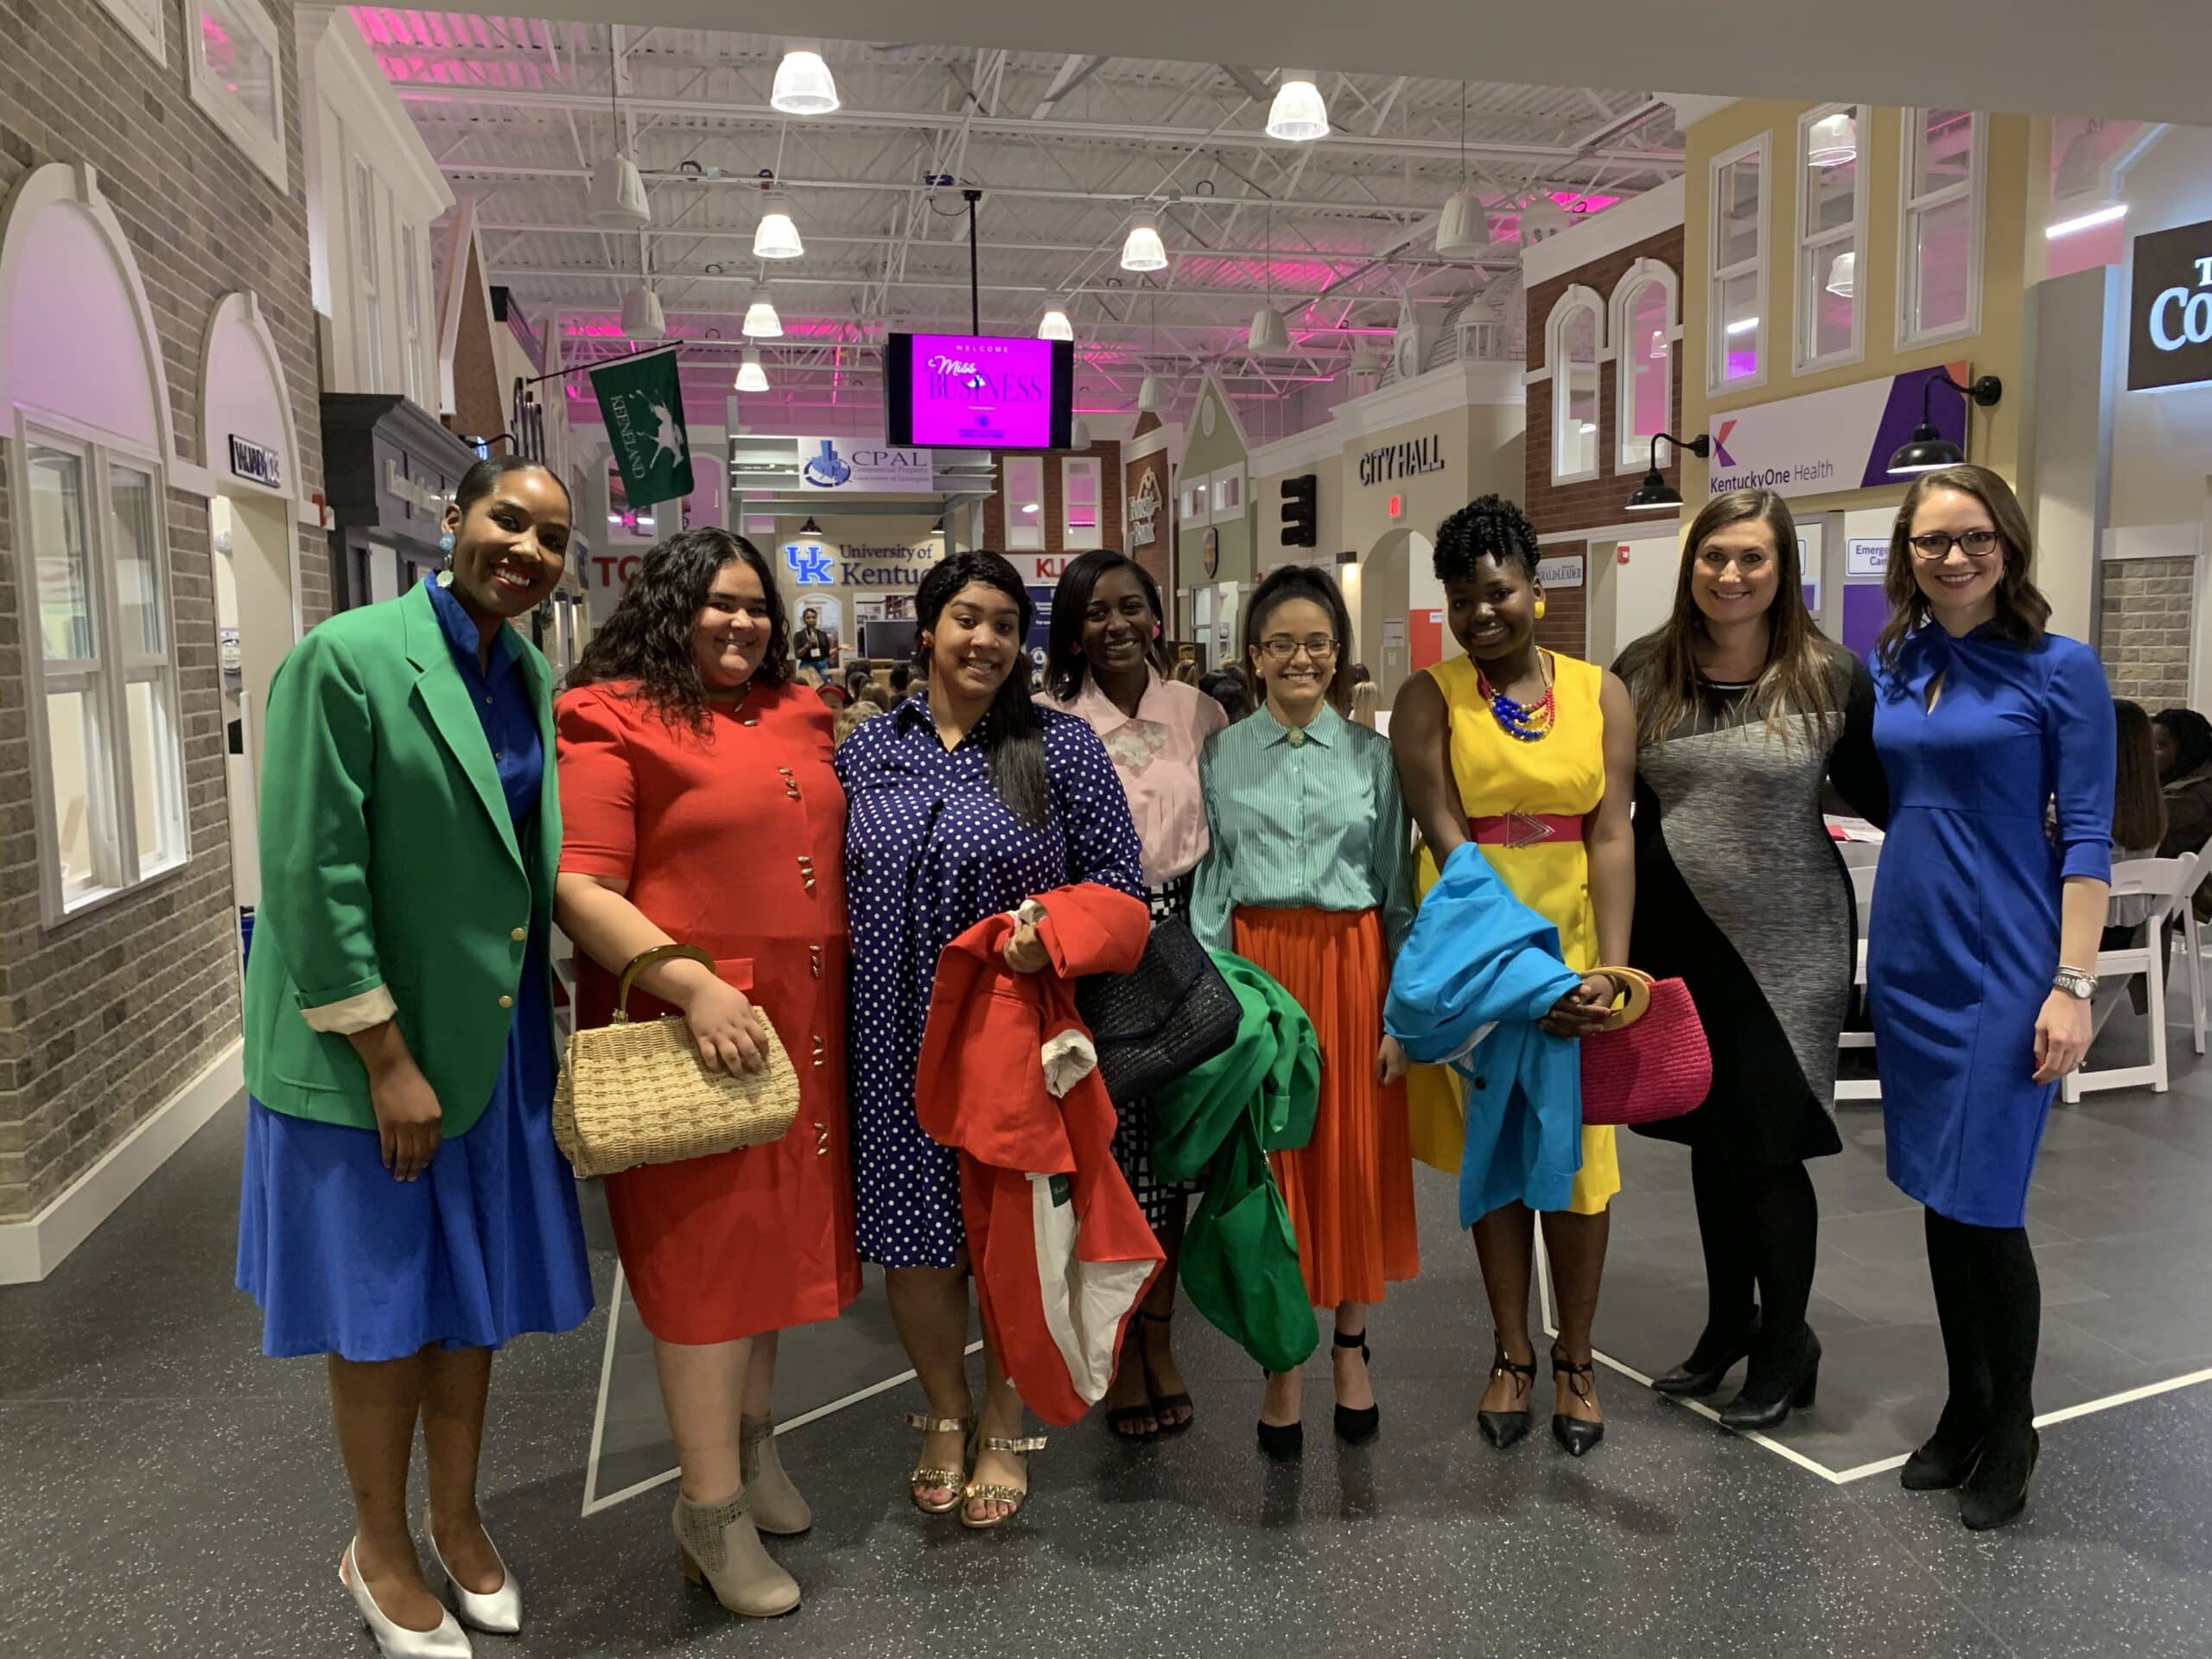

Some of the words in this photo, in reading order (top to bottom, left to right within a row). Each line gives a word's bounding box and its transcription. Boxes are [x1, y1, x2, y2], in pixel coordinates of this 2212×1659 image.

[956, 345, 1009, 353] WELCOME
[928, 355, 977, 376] Miss
[929, 372, 1044, 402] BUSINESS
[610, 395, 645, 480] KEENELAND
[851, 450, 927, 467] CPAL
[1360, 447, 1396, 486] CITY
[1398, 434, 1445, 478] HALL
[1710, 468, 1790, 493] KentuckyOne
[1794, 458, 1834, 481] Health
[785, 545, 834, 585] UK
[839, 544, 914, 563] University
[917, 543, 934, 558] of
[841, 561, 942, 586] Kentuc
